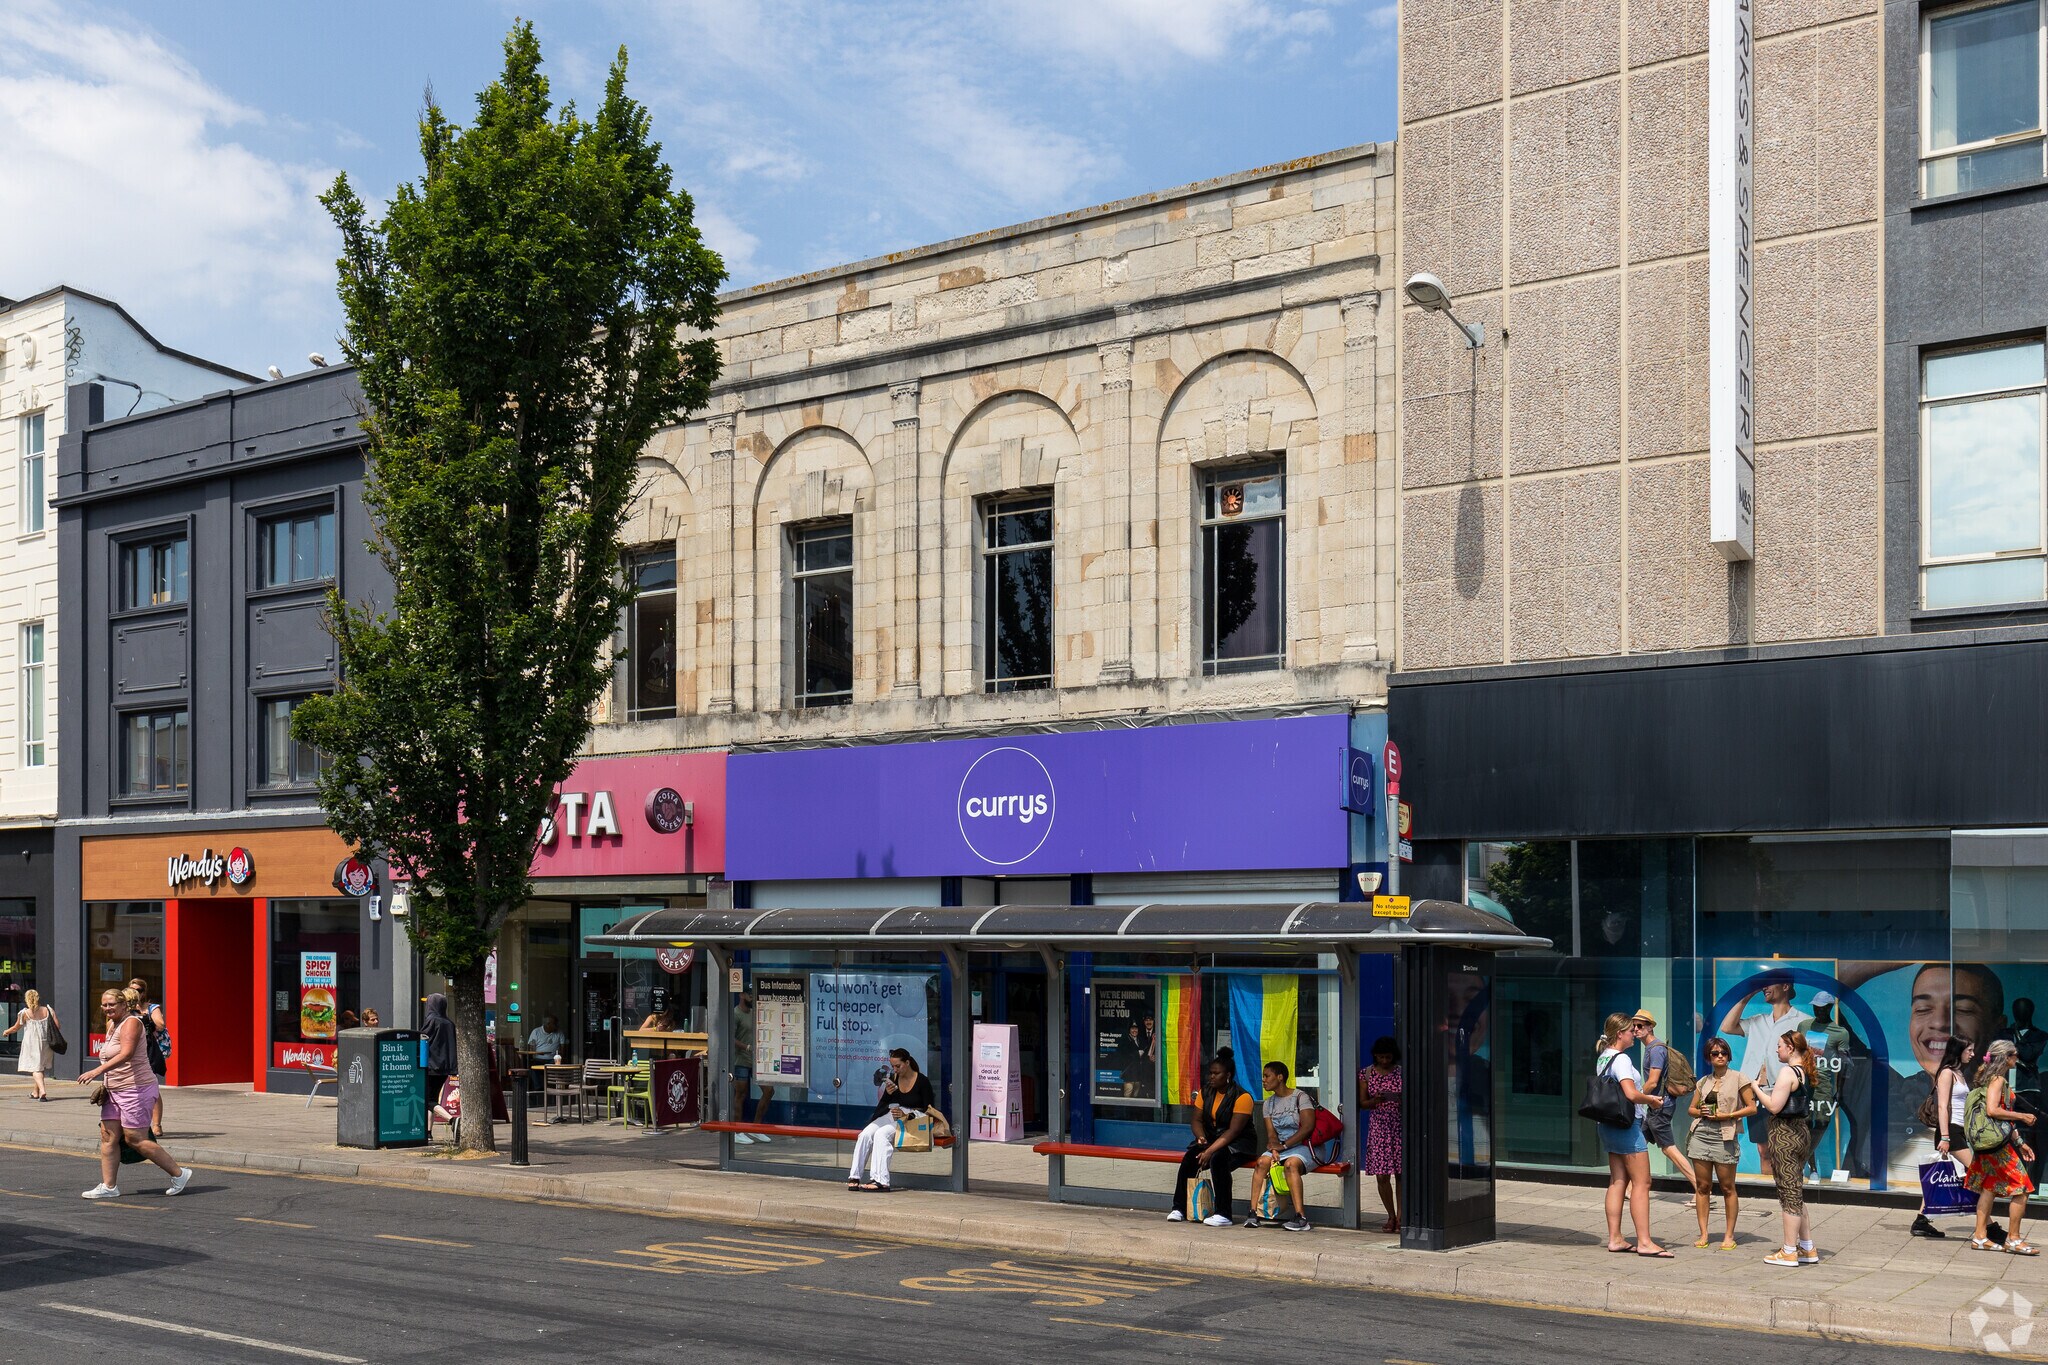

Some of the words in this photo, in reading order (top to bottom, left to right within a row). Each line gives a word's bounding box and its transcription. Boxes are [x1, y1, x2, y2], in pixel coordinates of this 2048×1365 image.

[1738, 133, 1748, 166] &
[1738, 177, 1749, 439] SPENCER
[1388, 749, 1397, 775] E
[1352, 775, 1369, 790] currys
[658, 791, 679, 805] COSTA
[966, 794, 1048, 824] currys
[656, 813, 682, 832] COFFEE
[168, 848, 223, 887] Wendy's
[305, 960, 331, 970] SPICY
[660, 952, 690, 969] COFFEE
[760, 981, 771, 989] Bus
[772, 981, 802, 990] Information
[817, 979, 839, 993] You
[843, 980, 878, 995] won't
[881, 982, 902, 998] get
[1100, 991, 1120, 999] WE'RE
[1121, 991, 1145, 1000] HIRING
[816, 998, 826, 1011] it
[829, 1000, 884, 1016] cheaper.
[1100, 1000, 1126, 1009] PEOPLE
[1100, 1009, 1115, 1018] LIKE
[1116, 1009, 1130, 1018] YOU
[816, 1016, 838, 1031] Full
[842, 1017, 872, 1035] stop.
[282, 1047, 312, 1065] Wendy's
[381, 1044, 396, 1052] Bin
[396, 1044, 404, 1052] it
[392, 1053, 410, 1061] take
[381, 1062, 389, 1071] it
[390, 1062, 412, 1071] home
